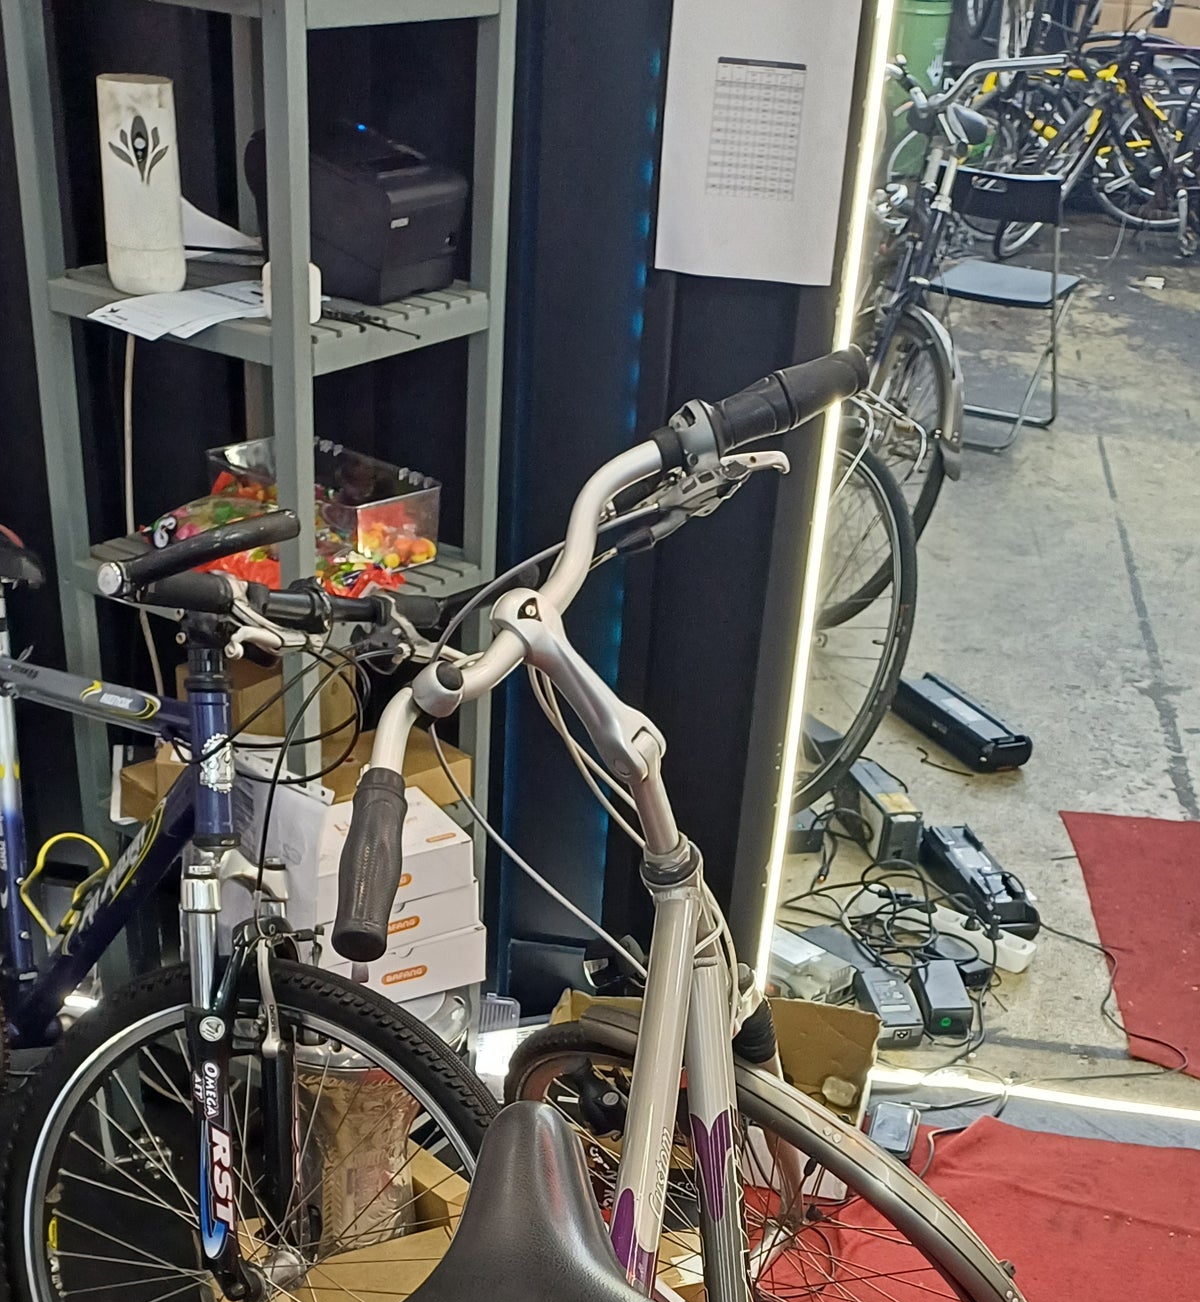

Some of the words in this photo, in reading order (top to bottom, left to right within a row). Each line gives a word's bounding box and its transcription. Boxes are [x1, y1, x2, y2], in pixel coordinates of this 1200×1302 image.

[385, 966, 424, 983] BAFANG
[204, 1062, 218, 1116] OMEGA
[211, 1127, 235, 1232] RST
